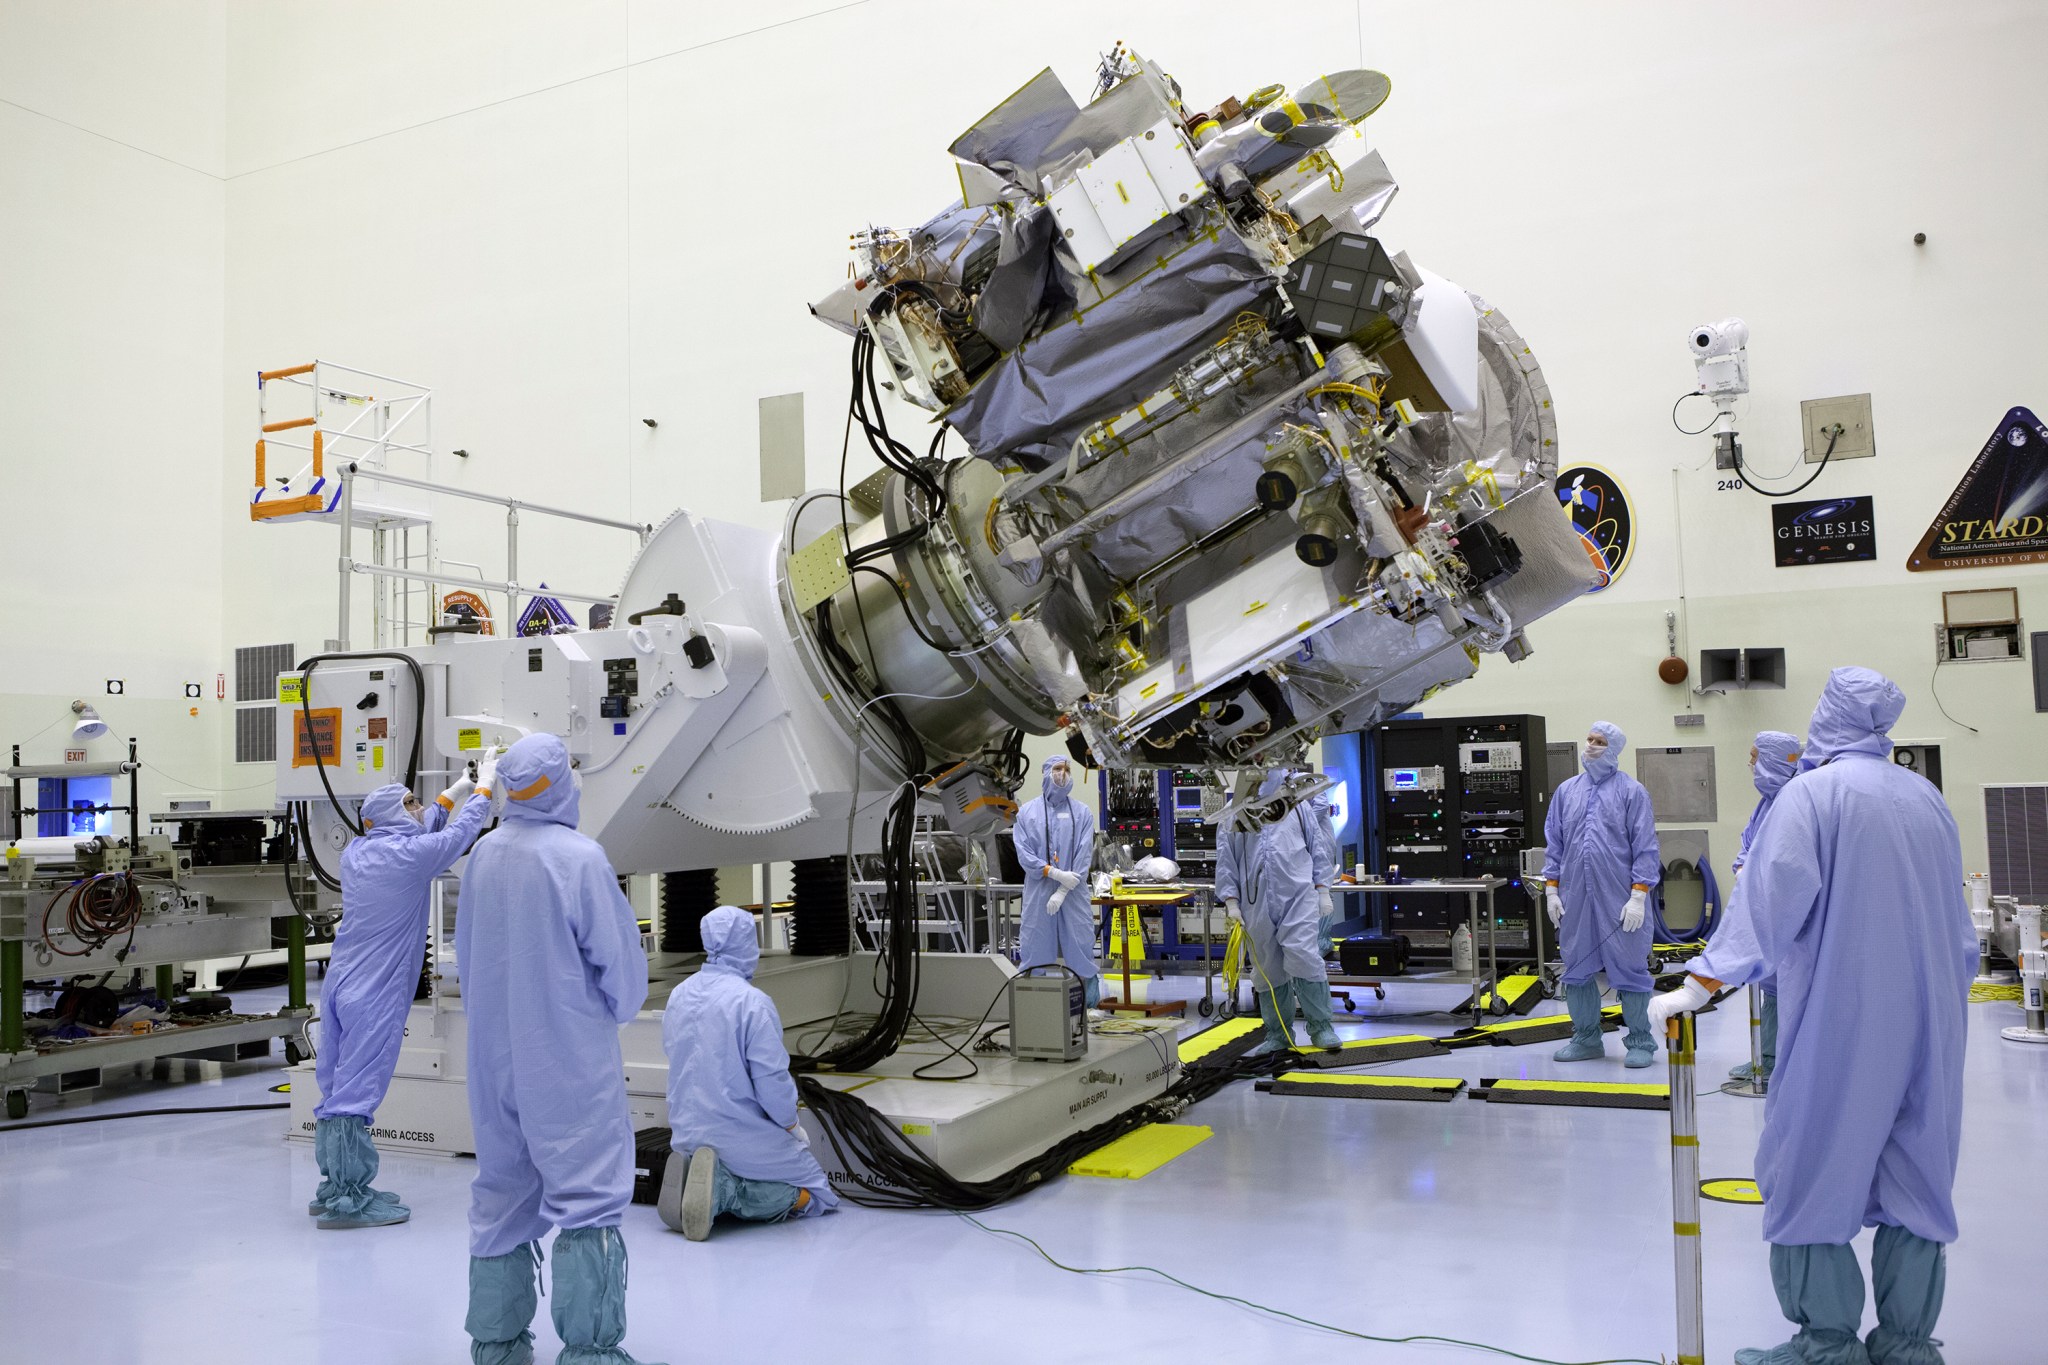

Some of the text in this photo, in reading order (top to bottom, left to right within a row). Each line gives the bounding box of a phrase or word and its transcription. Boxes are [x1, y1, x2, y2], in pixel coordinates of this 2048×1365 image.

[1717, 479, 1743, 491] 240
[1932, 431, 2003, 531] Jet Propulsion Laboratory
[1777, 520, 1870, 539] GENESIS
[1941, 515, 2048, 543] STARD
[1940, 543, 1972, 552] National
[1972, 540, 2016, 550] Aeronautics
[2015, 538, 2030, 546] and
[1944, 555, 2015, 567] UNIVERSITY
[2020, 554, 2032, 562] OF
[447, 594, 490, 635] RESUPPLY SERICES
[528, 618, 547, 628] OA-4
[67, 751, 85, 761] EXIT
[1069, 1089, 1108, 1115] MAIN AIR SUPPLY
[365, 1127, 398, 1139] EARING
[399, 1131, 436, 1143] ACCESS
